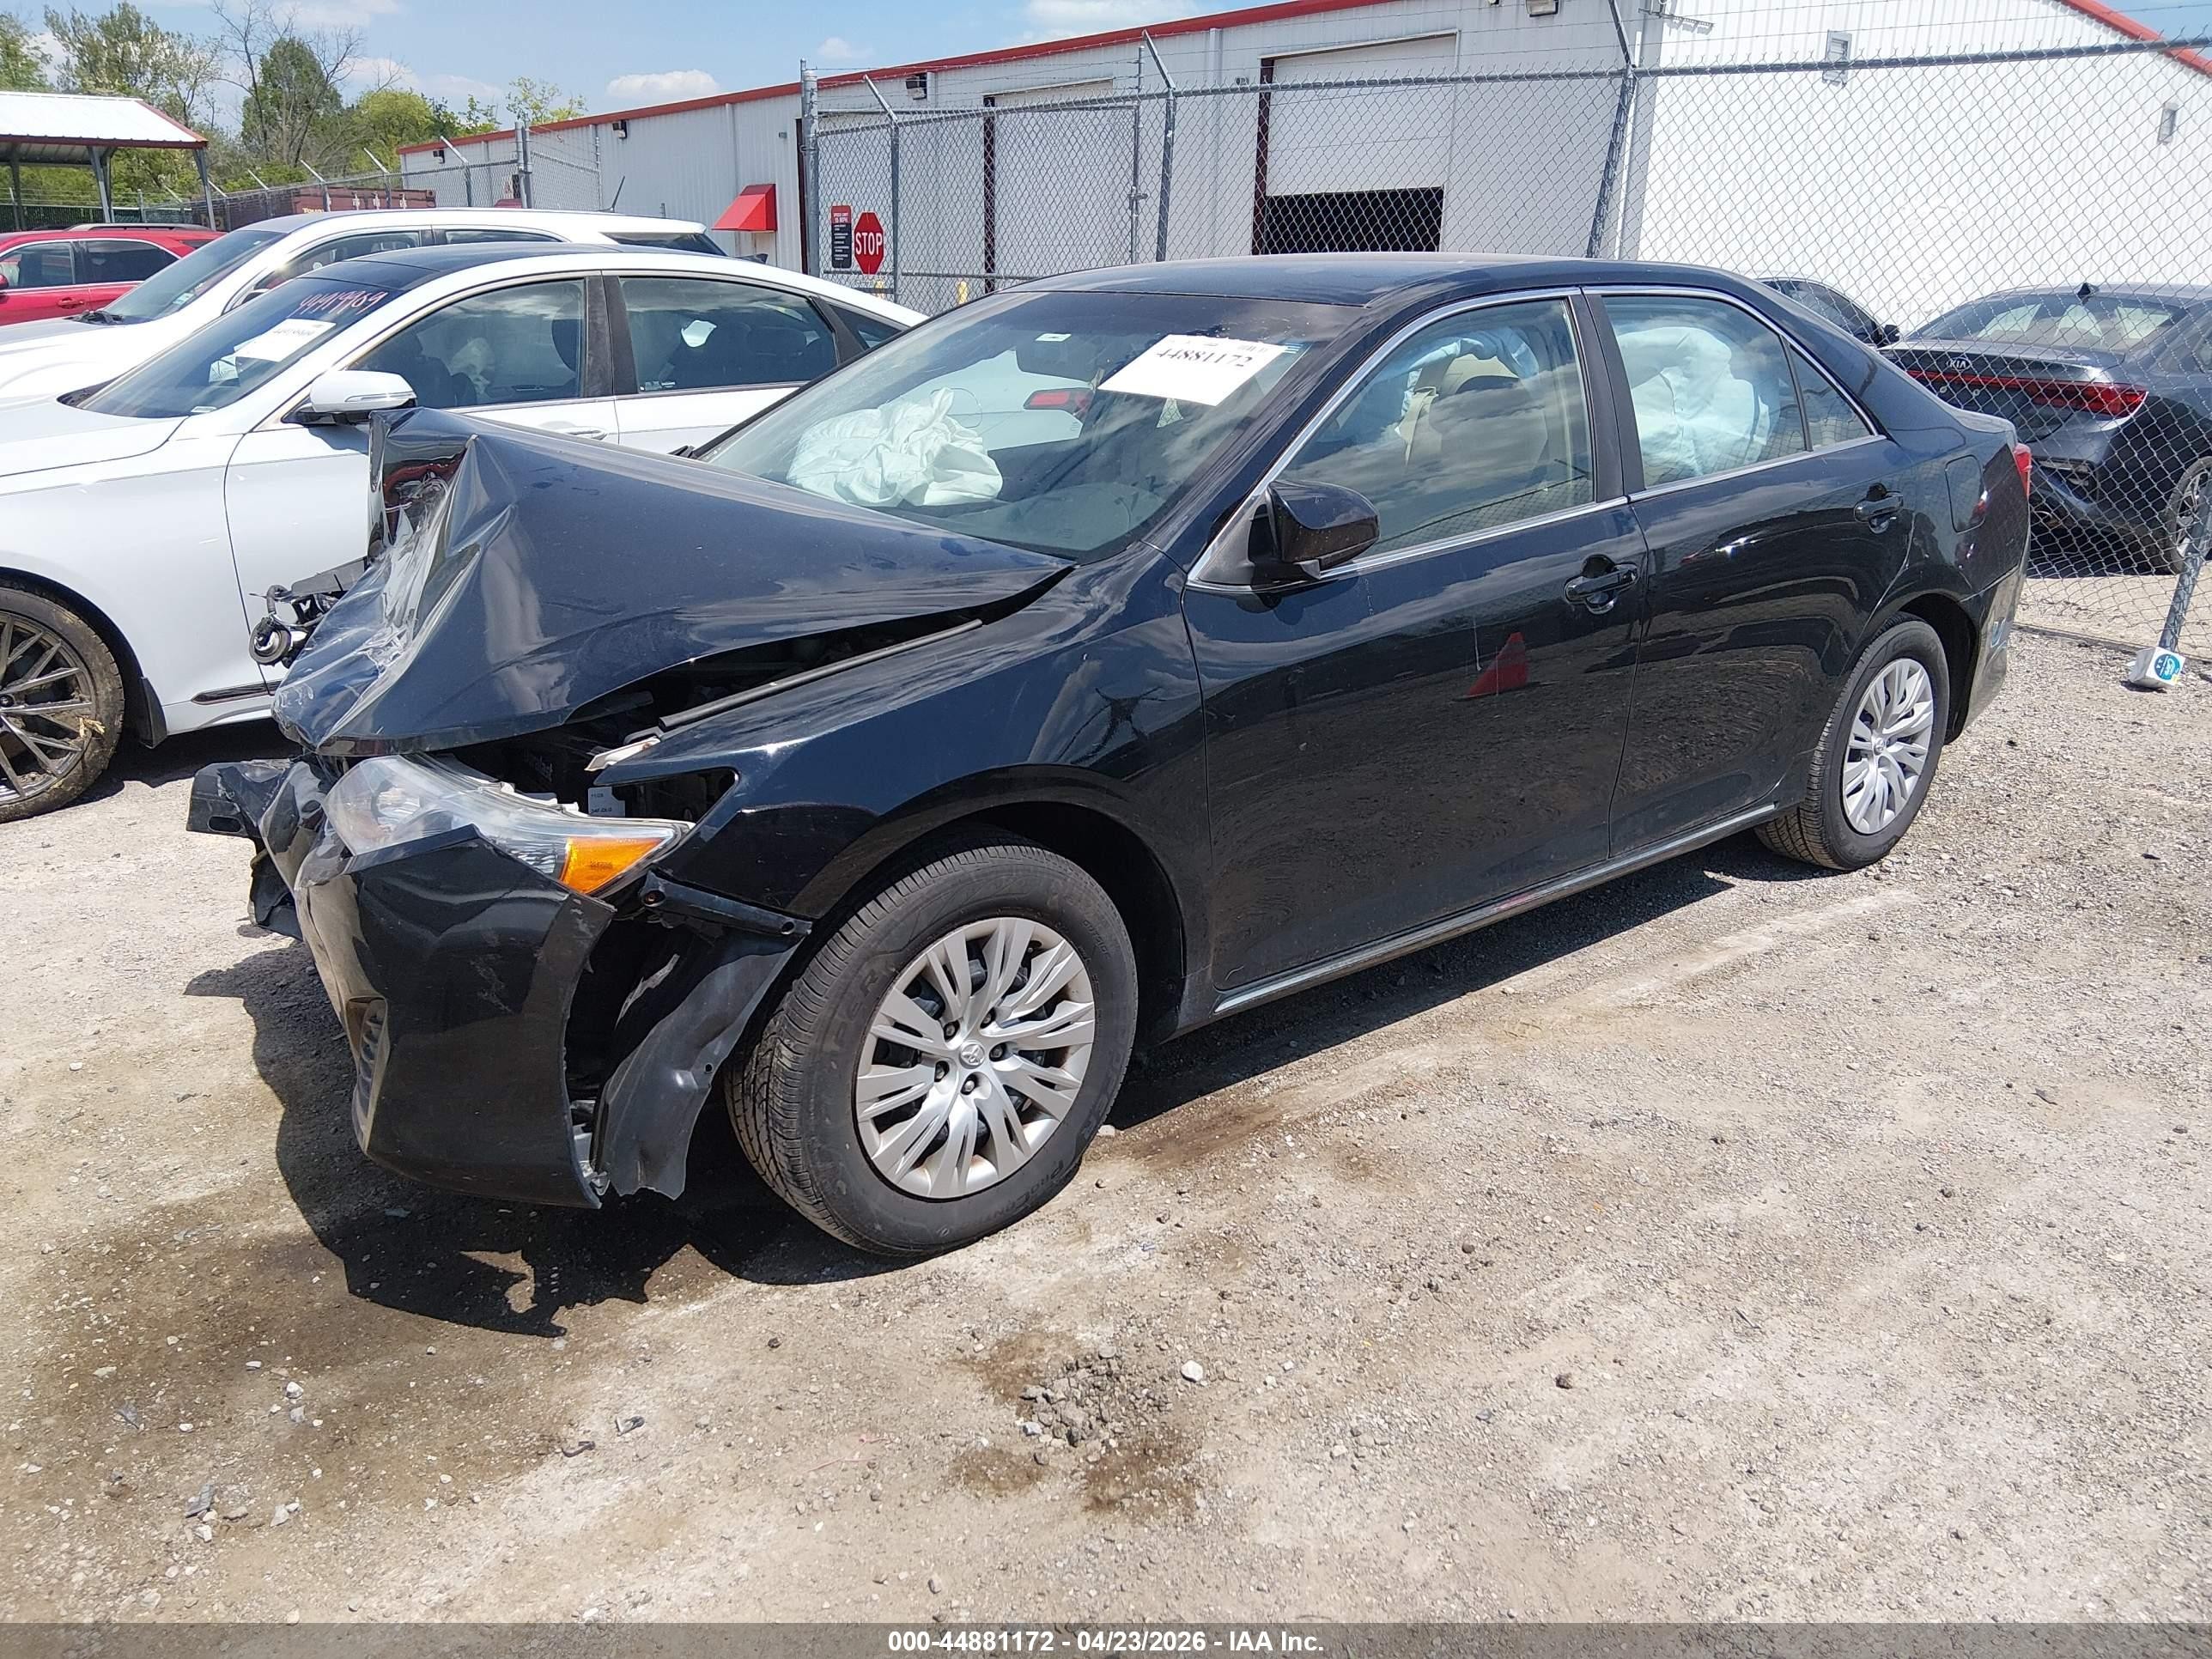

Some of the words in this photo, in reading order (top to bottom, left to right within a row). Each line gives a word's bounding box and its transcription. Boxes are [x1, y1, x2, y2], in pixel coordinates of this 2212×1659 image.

[855, 232, 883, 256] STOP
[1156, 348, 1254, 367] 44881172
[1950, 360, 1966, 369] KIA
